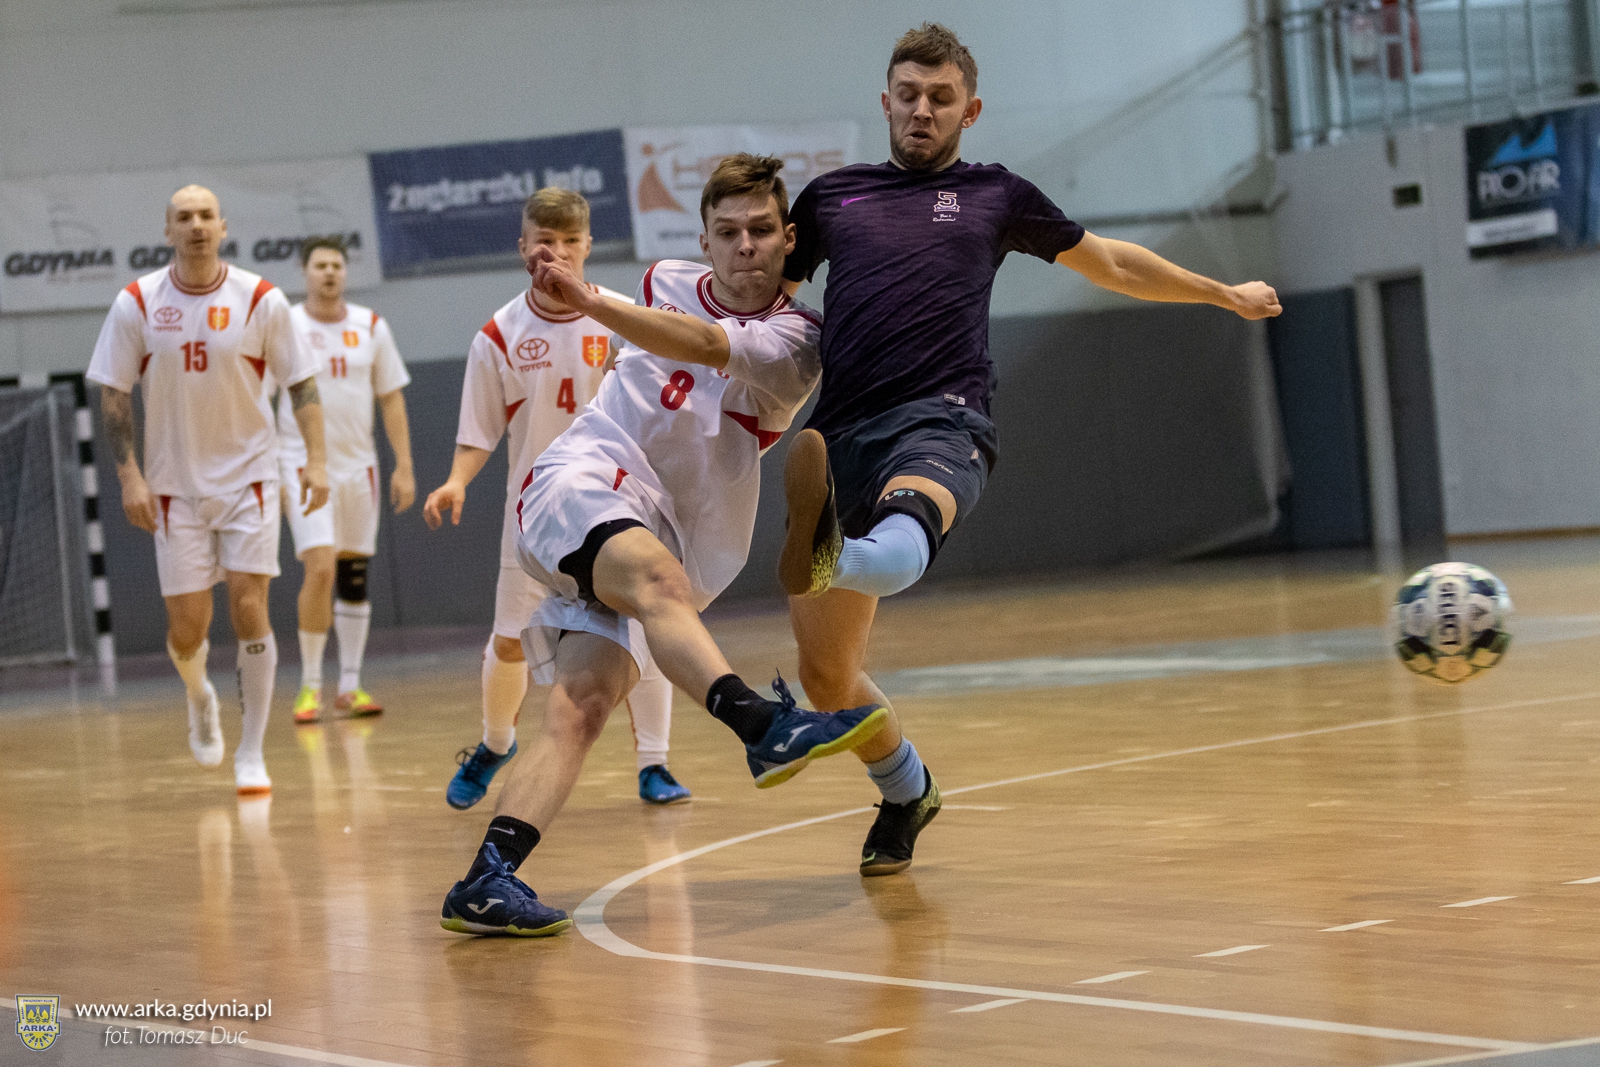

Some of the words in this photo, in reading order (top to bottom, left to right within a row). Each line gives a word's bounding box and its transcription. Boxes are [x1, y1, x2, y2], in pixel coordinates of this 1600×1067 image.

[4, 249, 114, 277] GDYNIA
[180, 341, 208, 373] 15
[330, 356, 347, 378] 11
[519, 361, 553, 373] TOYOTA
[556, 377, 577, 414] 4
[660, 369, 695, 411] 8
